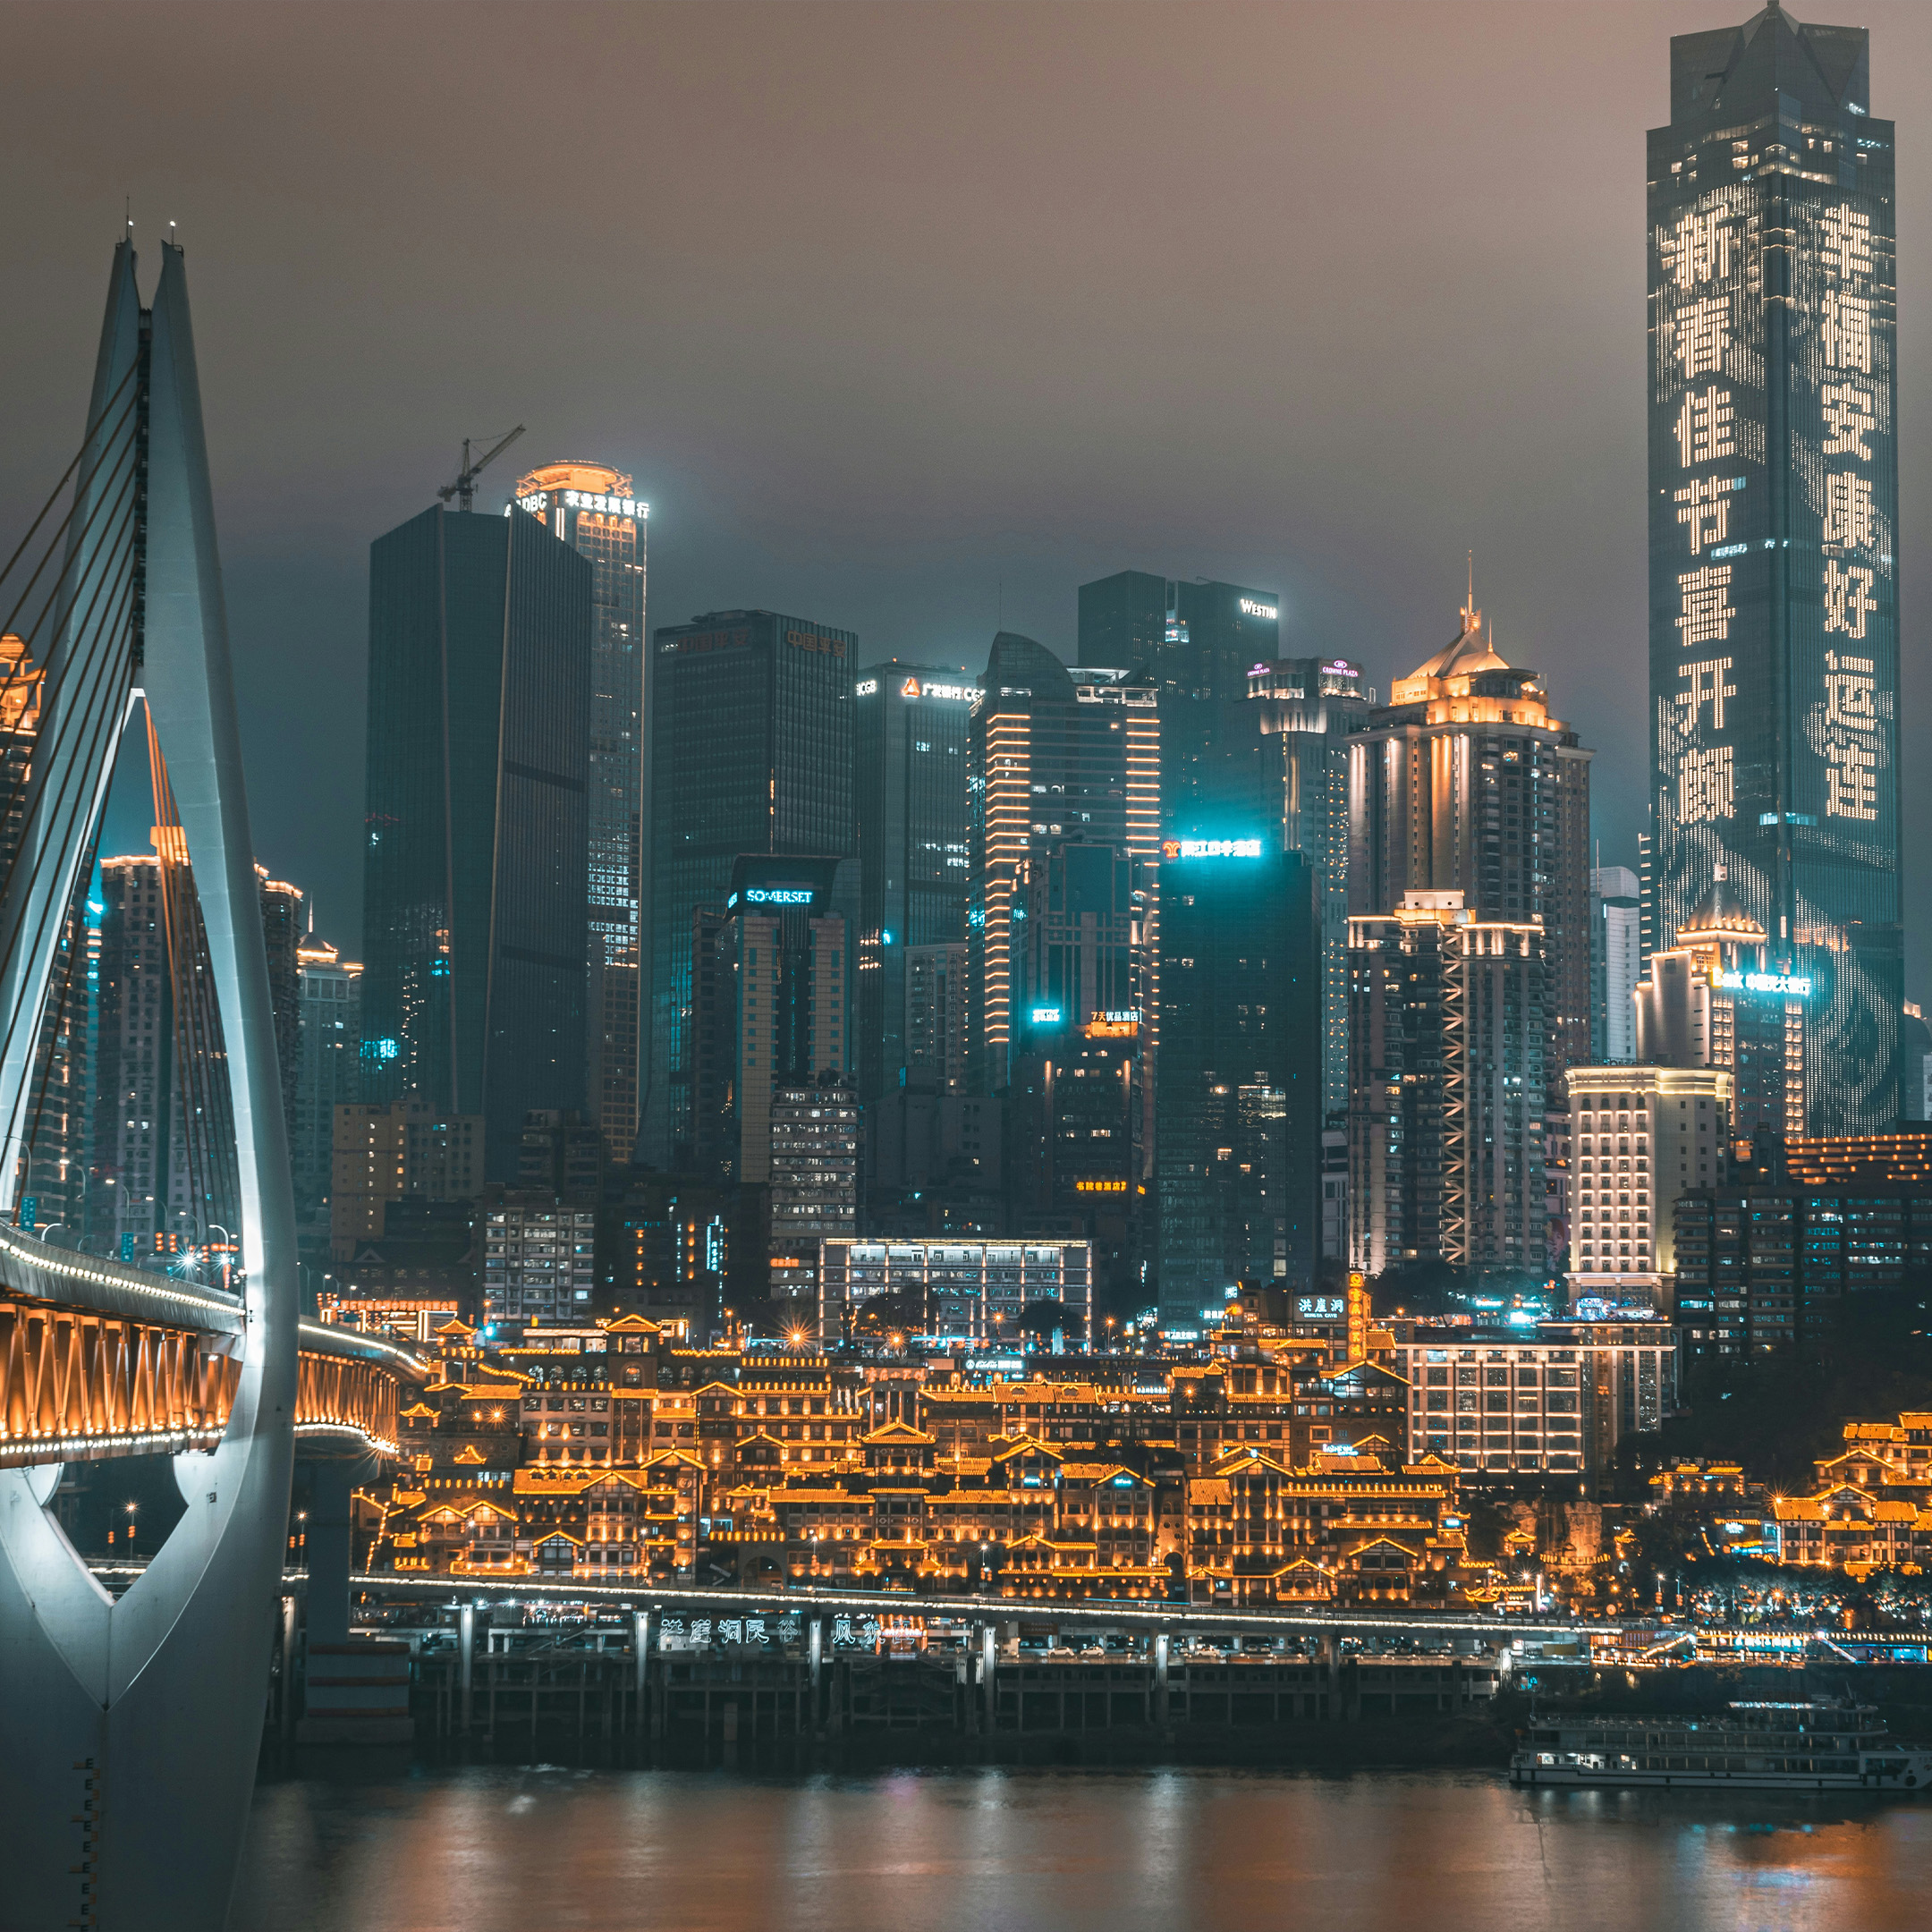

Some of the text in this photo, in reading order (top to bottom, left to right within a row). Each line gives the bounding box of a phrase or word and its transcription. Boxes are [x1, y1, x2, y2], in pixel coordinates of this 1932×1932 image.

[1673, 203, 1736, 824] 新春佳节喜开颜
[1821, 204, 1877, 820] 幸福安康好运连
[787, 630, 846, 658] 中国平安
[1322, 666, 1359, 678] CROWNE PLAZA
[747, 890, 812, 903] SOMERSET
[1090, 1011, 1139, 1022] 7天优品酒店
[1298, 1297, 1344, 1314] 洪崖洞
